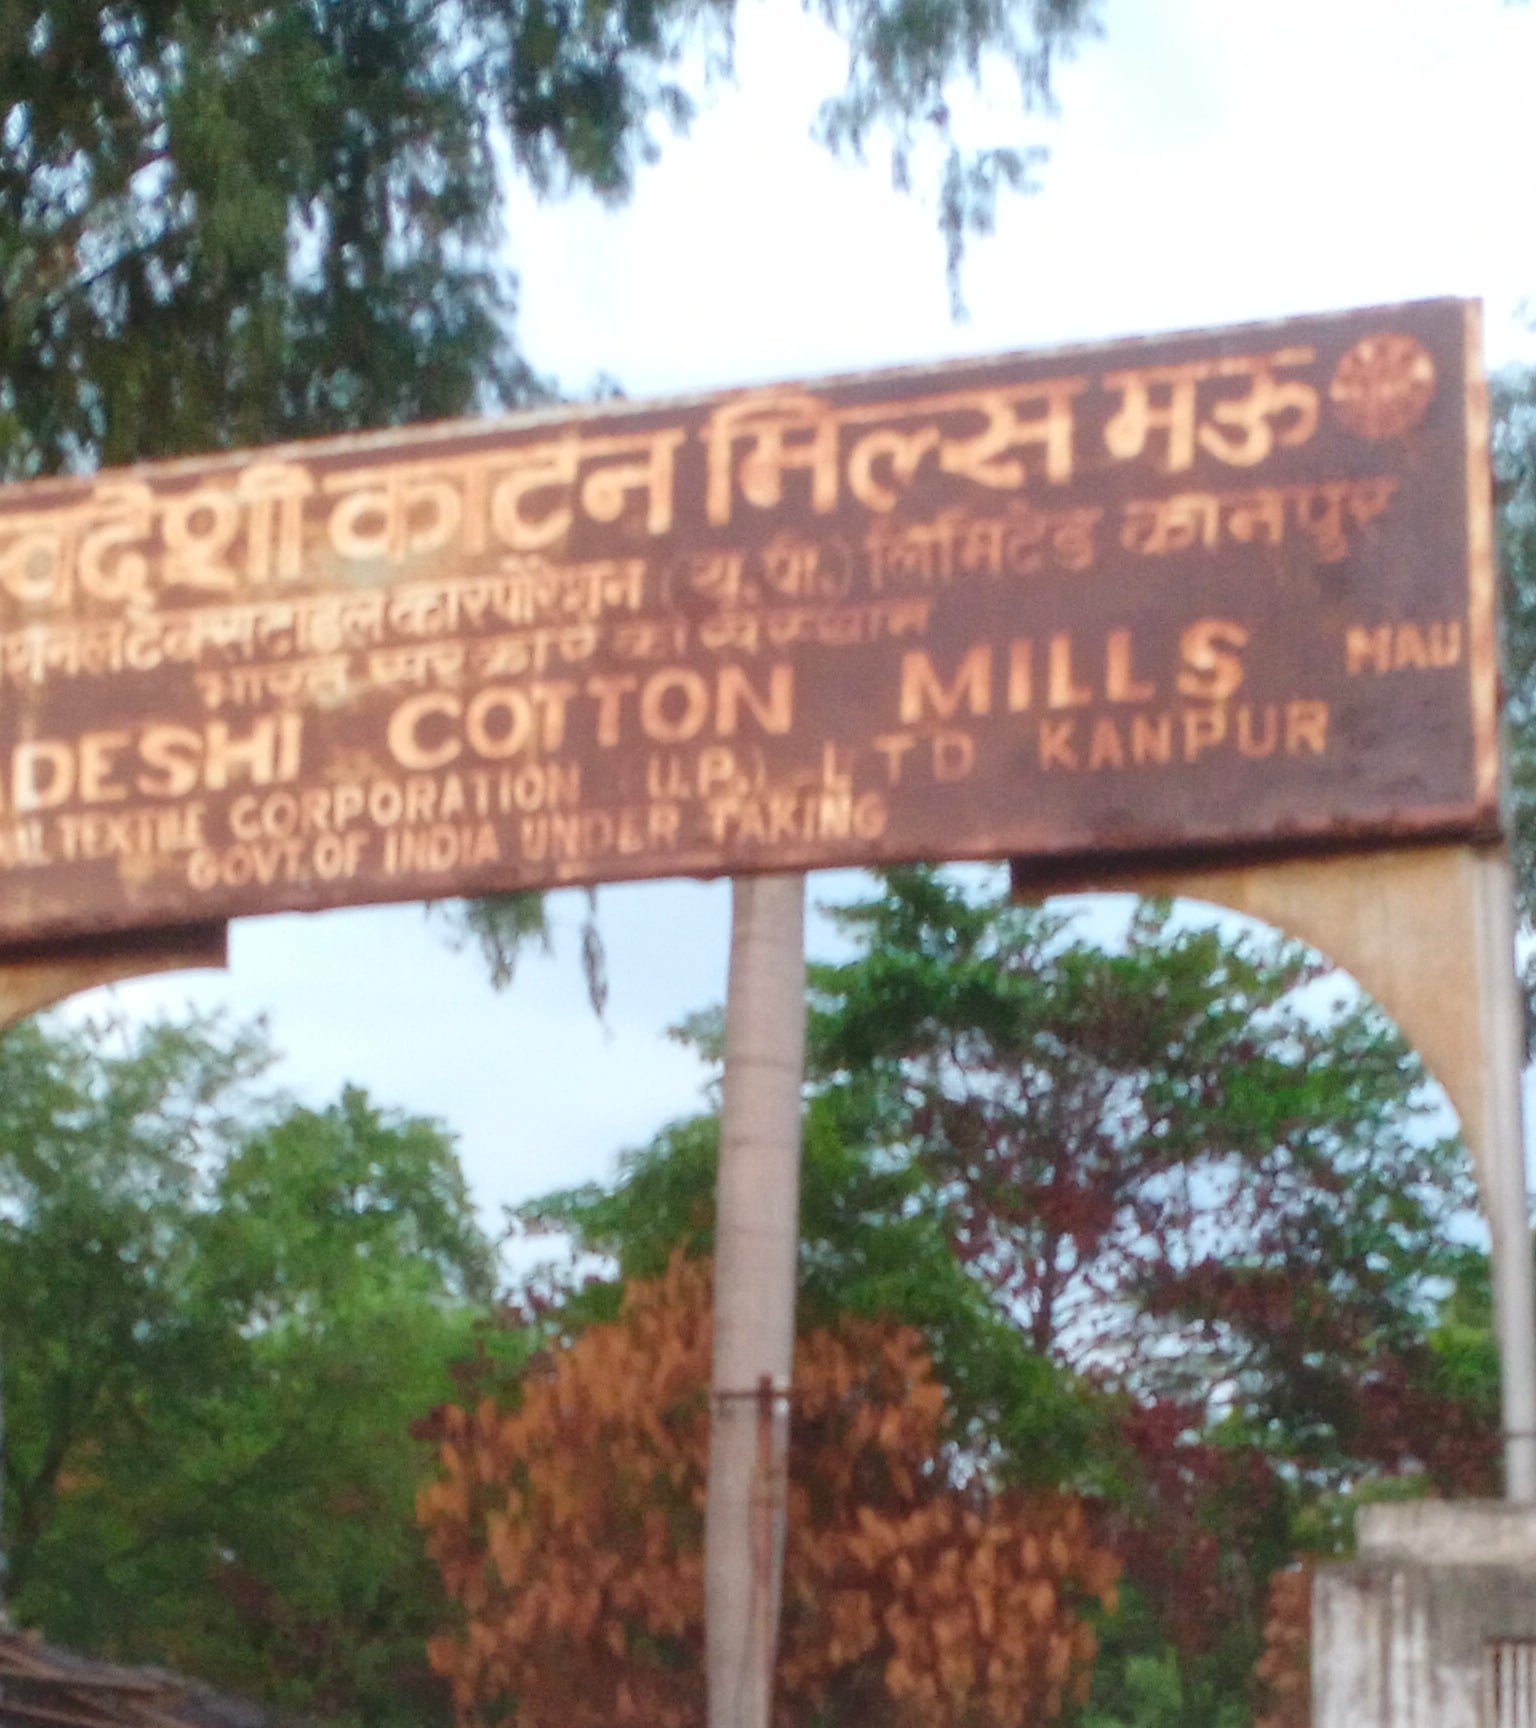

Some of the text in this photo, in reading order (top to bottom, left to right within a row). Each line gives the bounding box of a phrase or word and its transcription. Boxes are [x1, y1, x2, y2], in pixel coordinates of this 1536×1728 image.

[321, 426, 686, 564] काटन
[698, 376, 1086, 524] मिल्स
[1103, 346, 1320, 472] मऊ
[1120, 476, 1400, 563] कानपुर
[388, 664, 795, 770] COTTON
[898, 619, 1250, 723] MILLS
[1345, 621, 1462, 676] MAU
[57, 802, 209, 860] TEXTILE
[228, 762, 582, 842] CORPORATION
[1039, 700, 1330, 774] KANPUR
[312, 828, 368, 880] OF
[384, 820, 501, 877] INDIA
